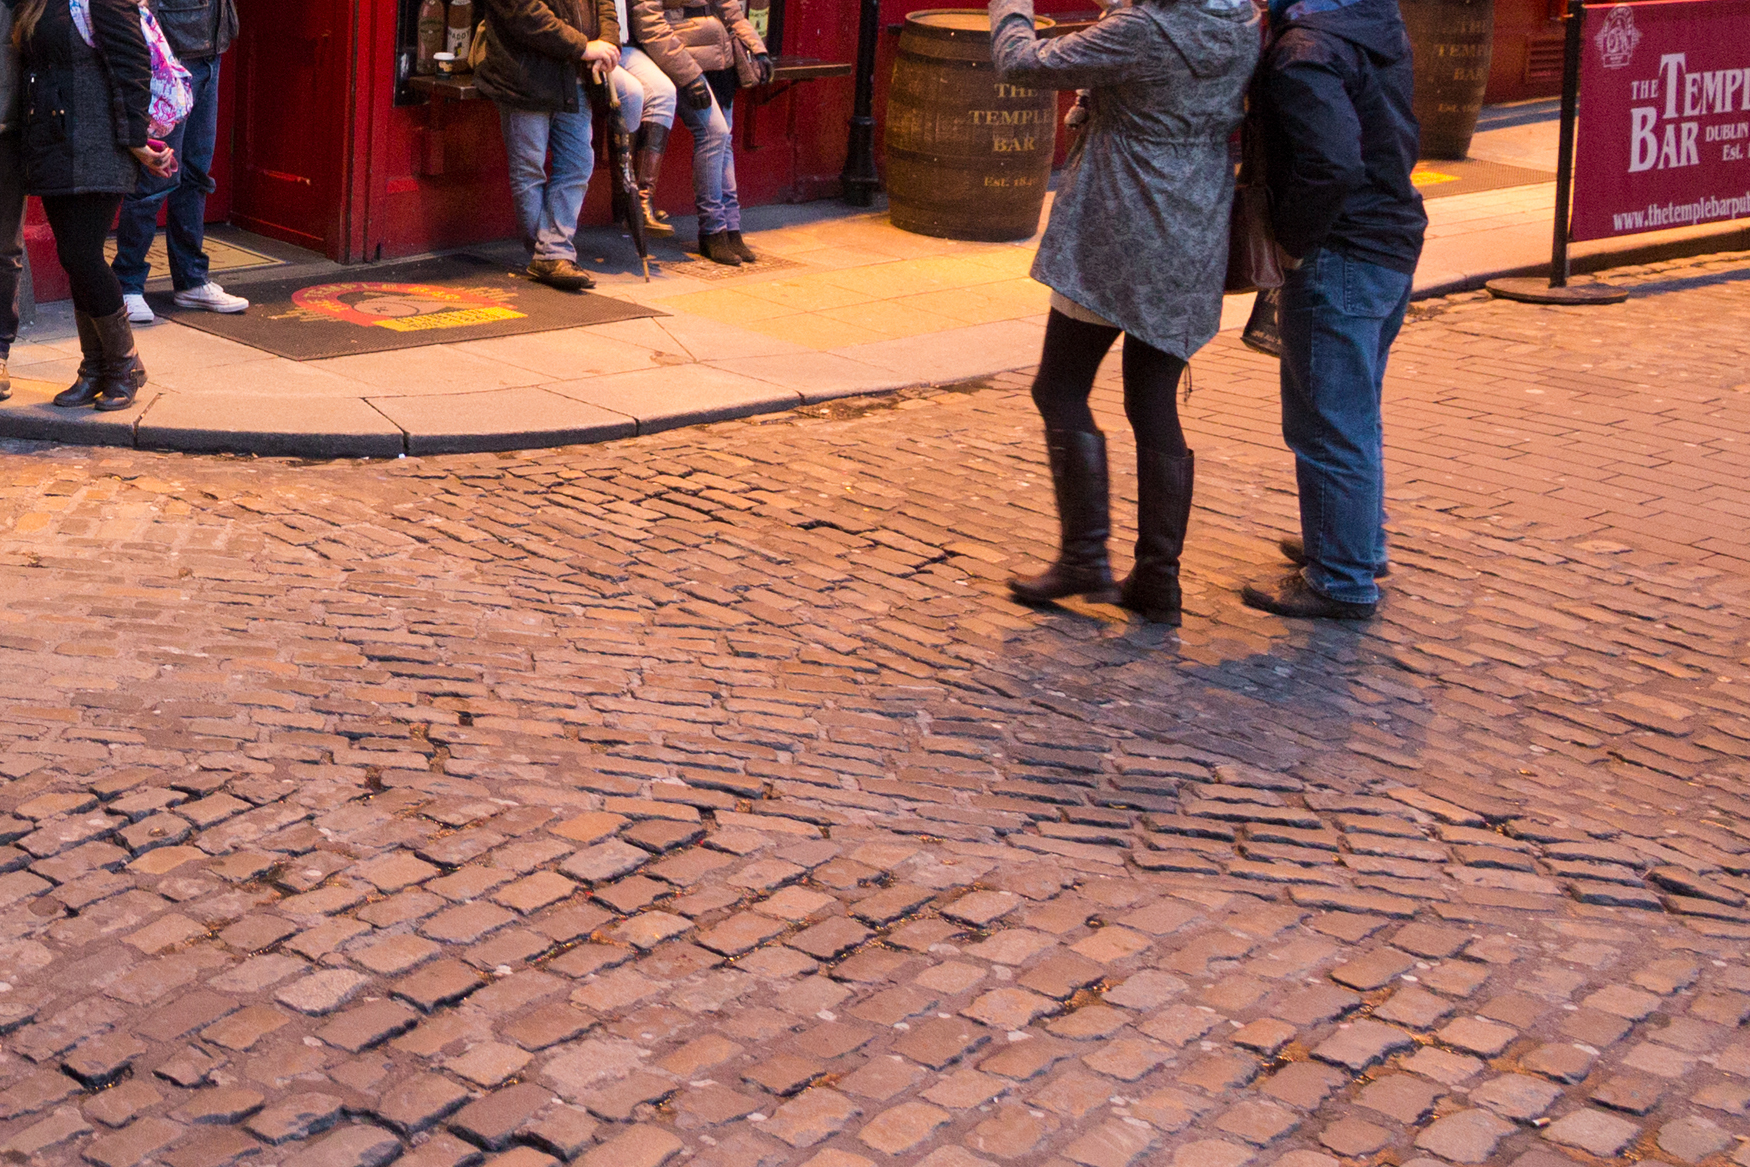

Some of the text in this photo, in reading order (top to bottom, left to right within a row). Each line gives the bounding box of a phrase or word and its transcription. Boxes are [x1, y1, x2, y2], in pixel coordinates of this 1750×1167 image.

[1631, 79, 1659, 102] THE
[993, 136, 1036, 152] BAR
[1628, 106, 1749, 173] BAR DUBLIN
[1722, 143, 1744, 162] Est.
